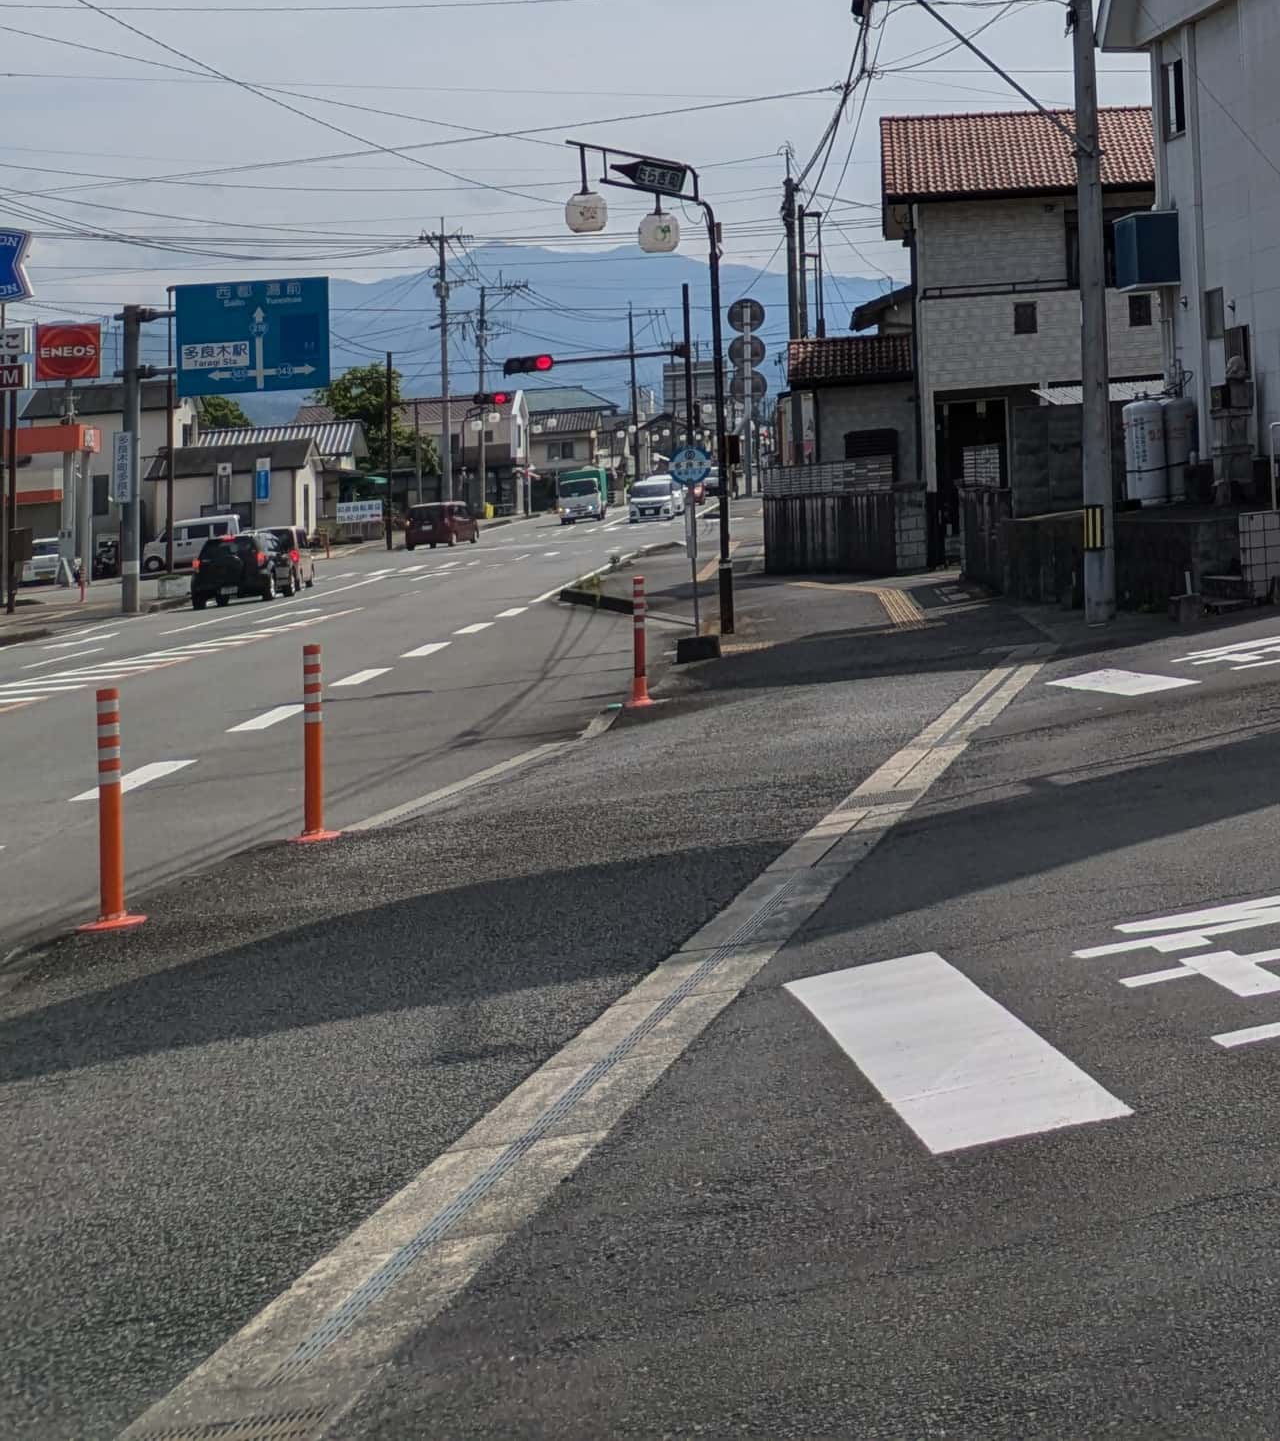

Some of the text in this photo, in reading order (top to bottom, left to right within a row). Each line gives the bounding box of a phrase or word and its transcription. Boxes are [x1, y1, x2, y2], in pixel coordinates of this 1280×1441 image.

[40, 344, 96, 359] ENEOS
[183, 343, 249, 360] 多良木駅
